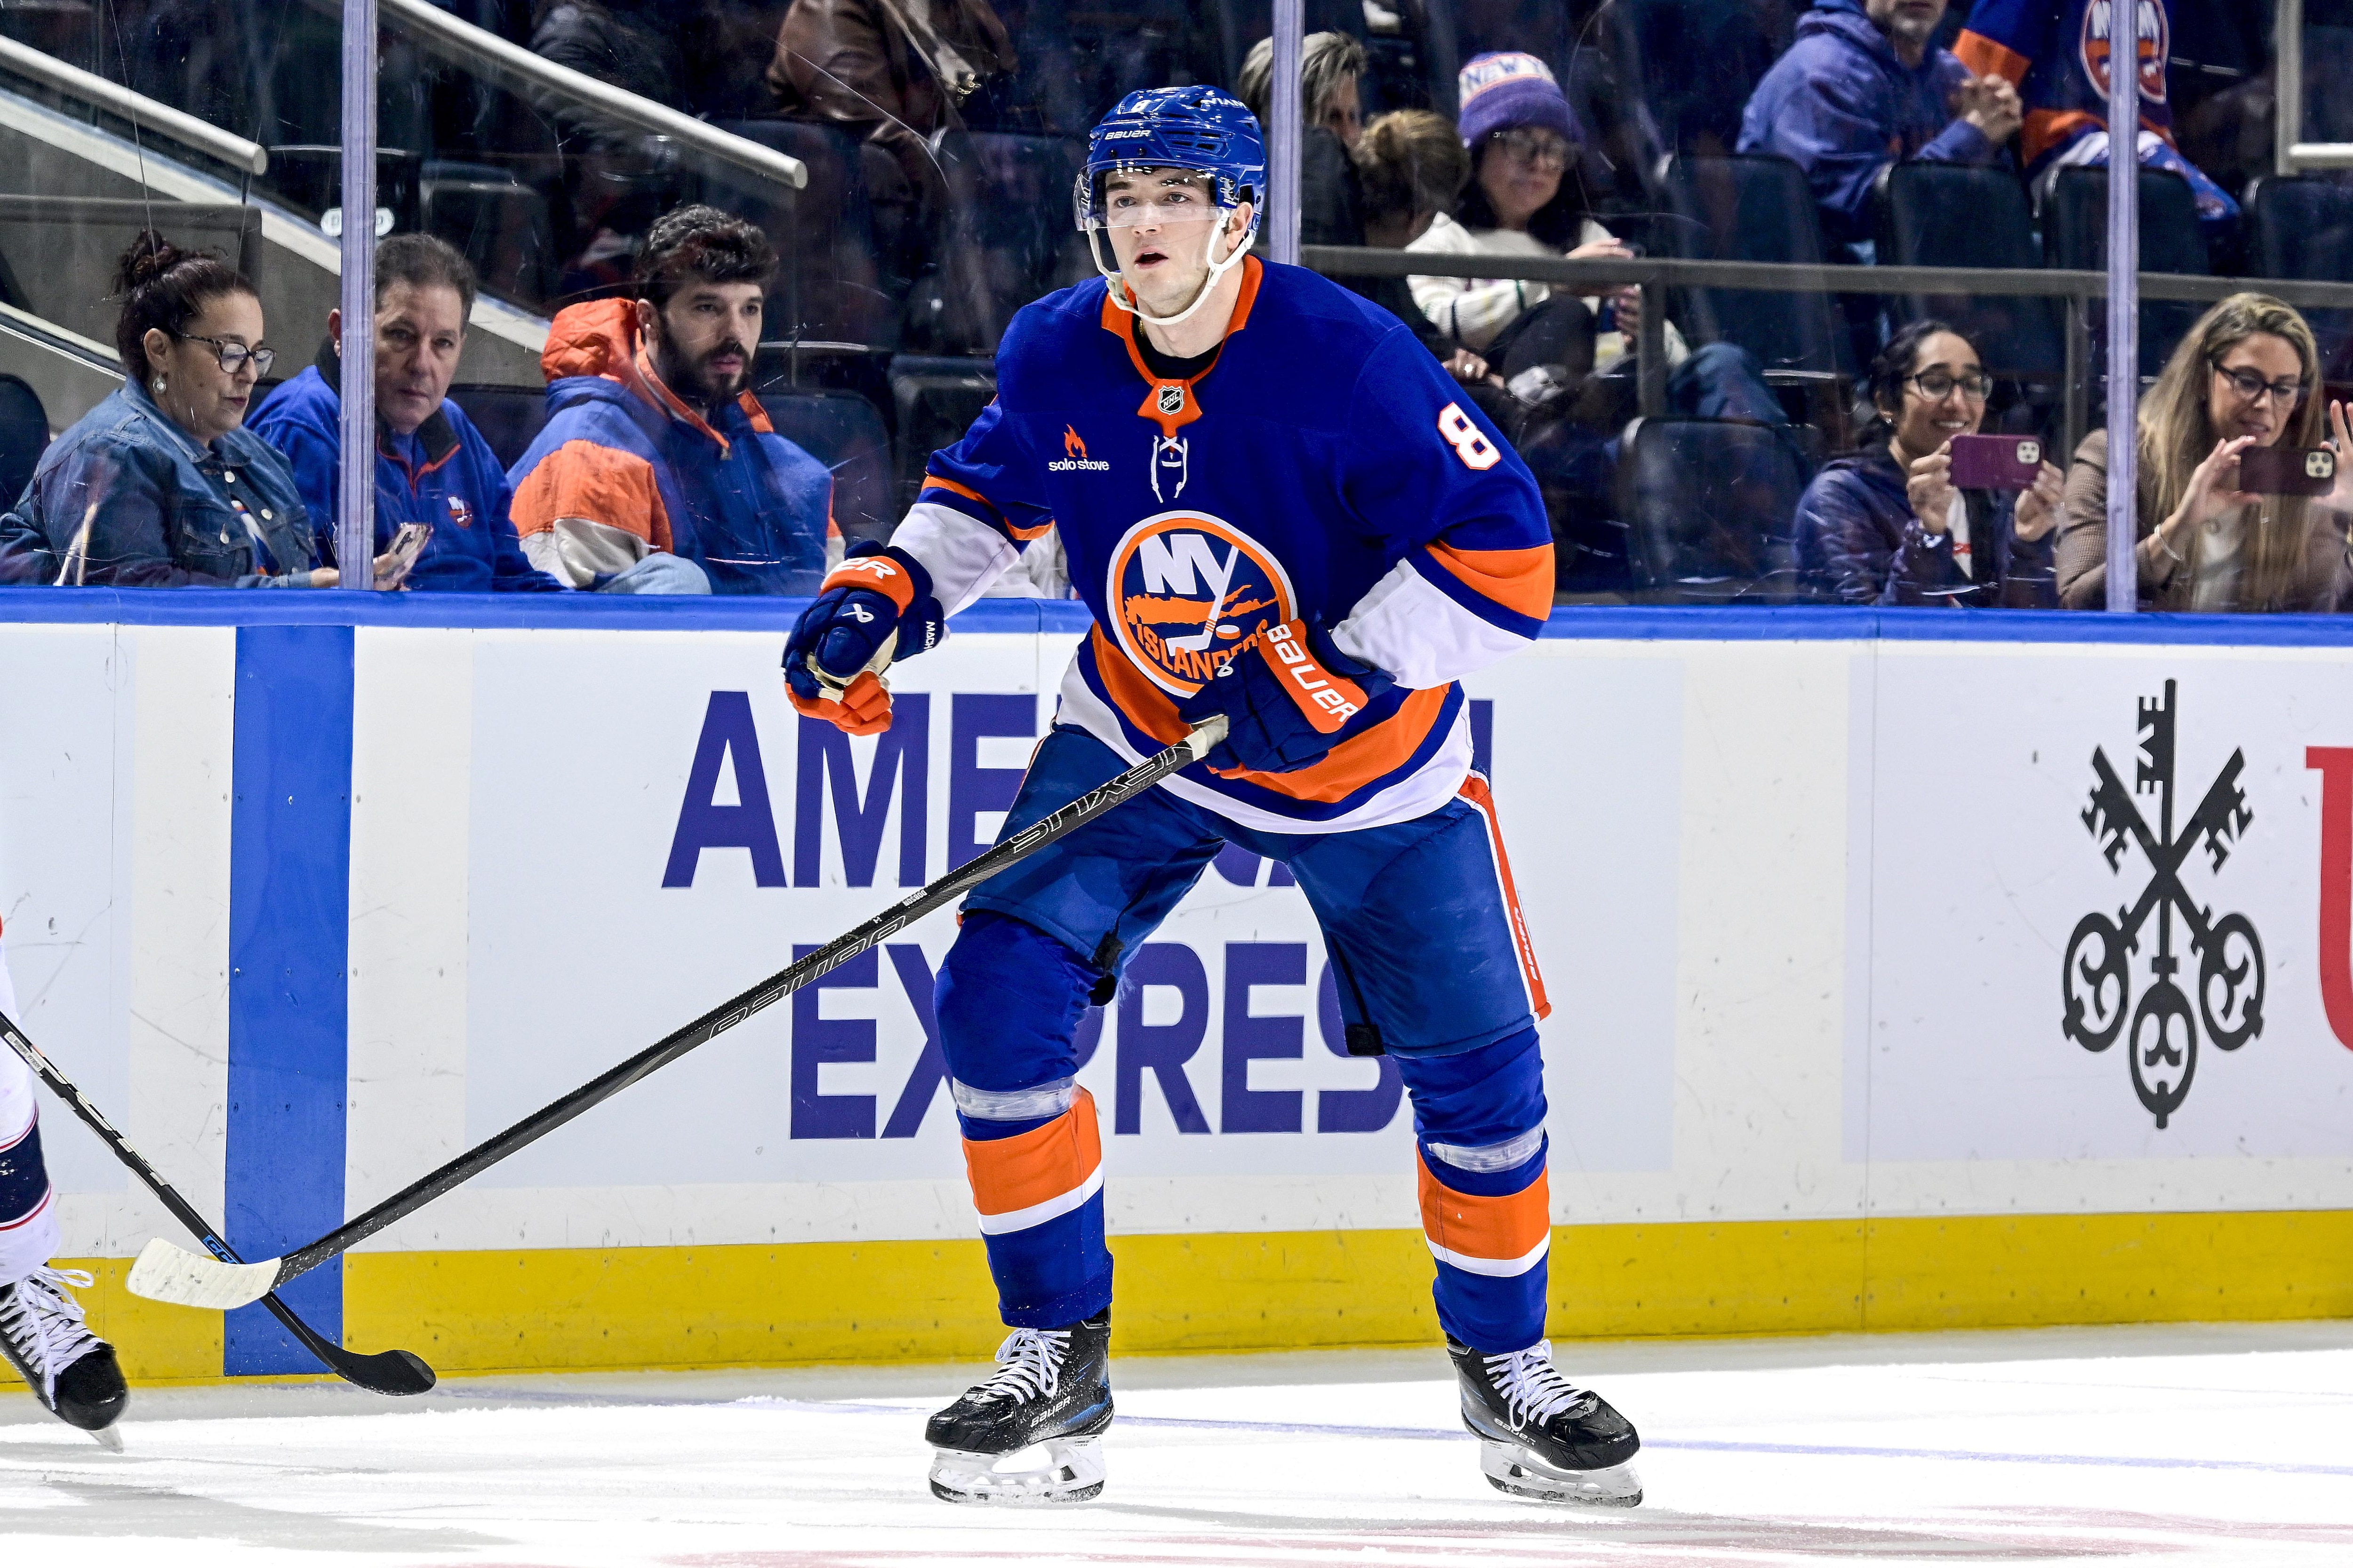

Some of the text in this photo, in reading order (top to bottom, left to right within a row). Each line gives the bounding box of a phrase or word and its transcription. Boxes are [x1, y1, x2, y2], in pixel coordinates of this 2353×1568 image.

[1131, 99, 1152, 112] 8
[1104, 130, 1152, 140] BAUER
[1163, 393, 1179, 408] NHL
[1437, 402, 1501, 470] 8
[1048, 458, 1110, 471] solo stove
[1139, 534, 1239, 612] NY
[924, 621, 936, 649] MACH
[1267, 624, 1360, 722] BAUER
[902, 889, 927, 907] DOBSON
[790, 943, 1407, 1139] EXRES
[206, 1239, 238, 1264] CC
[1031, 1396, 1072, 1427] BAUER
[1494, 1417, 1536, 1446] BAUER
